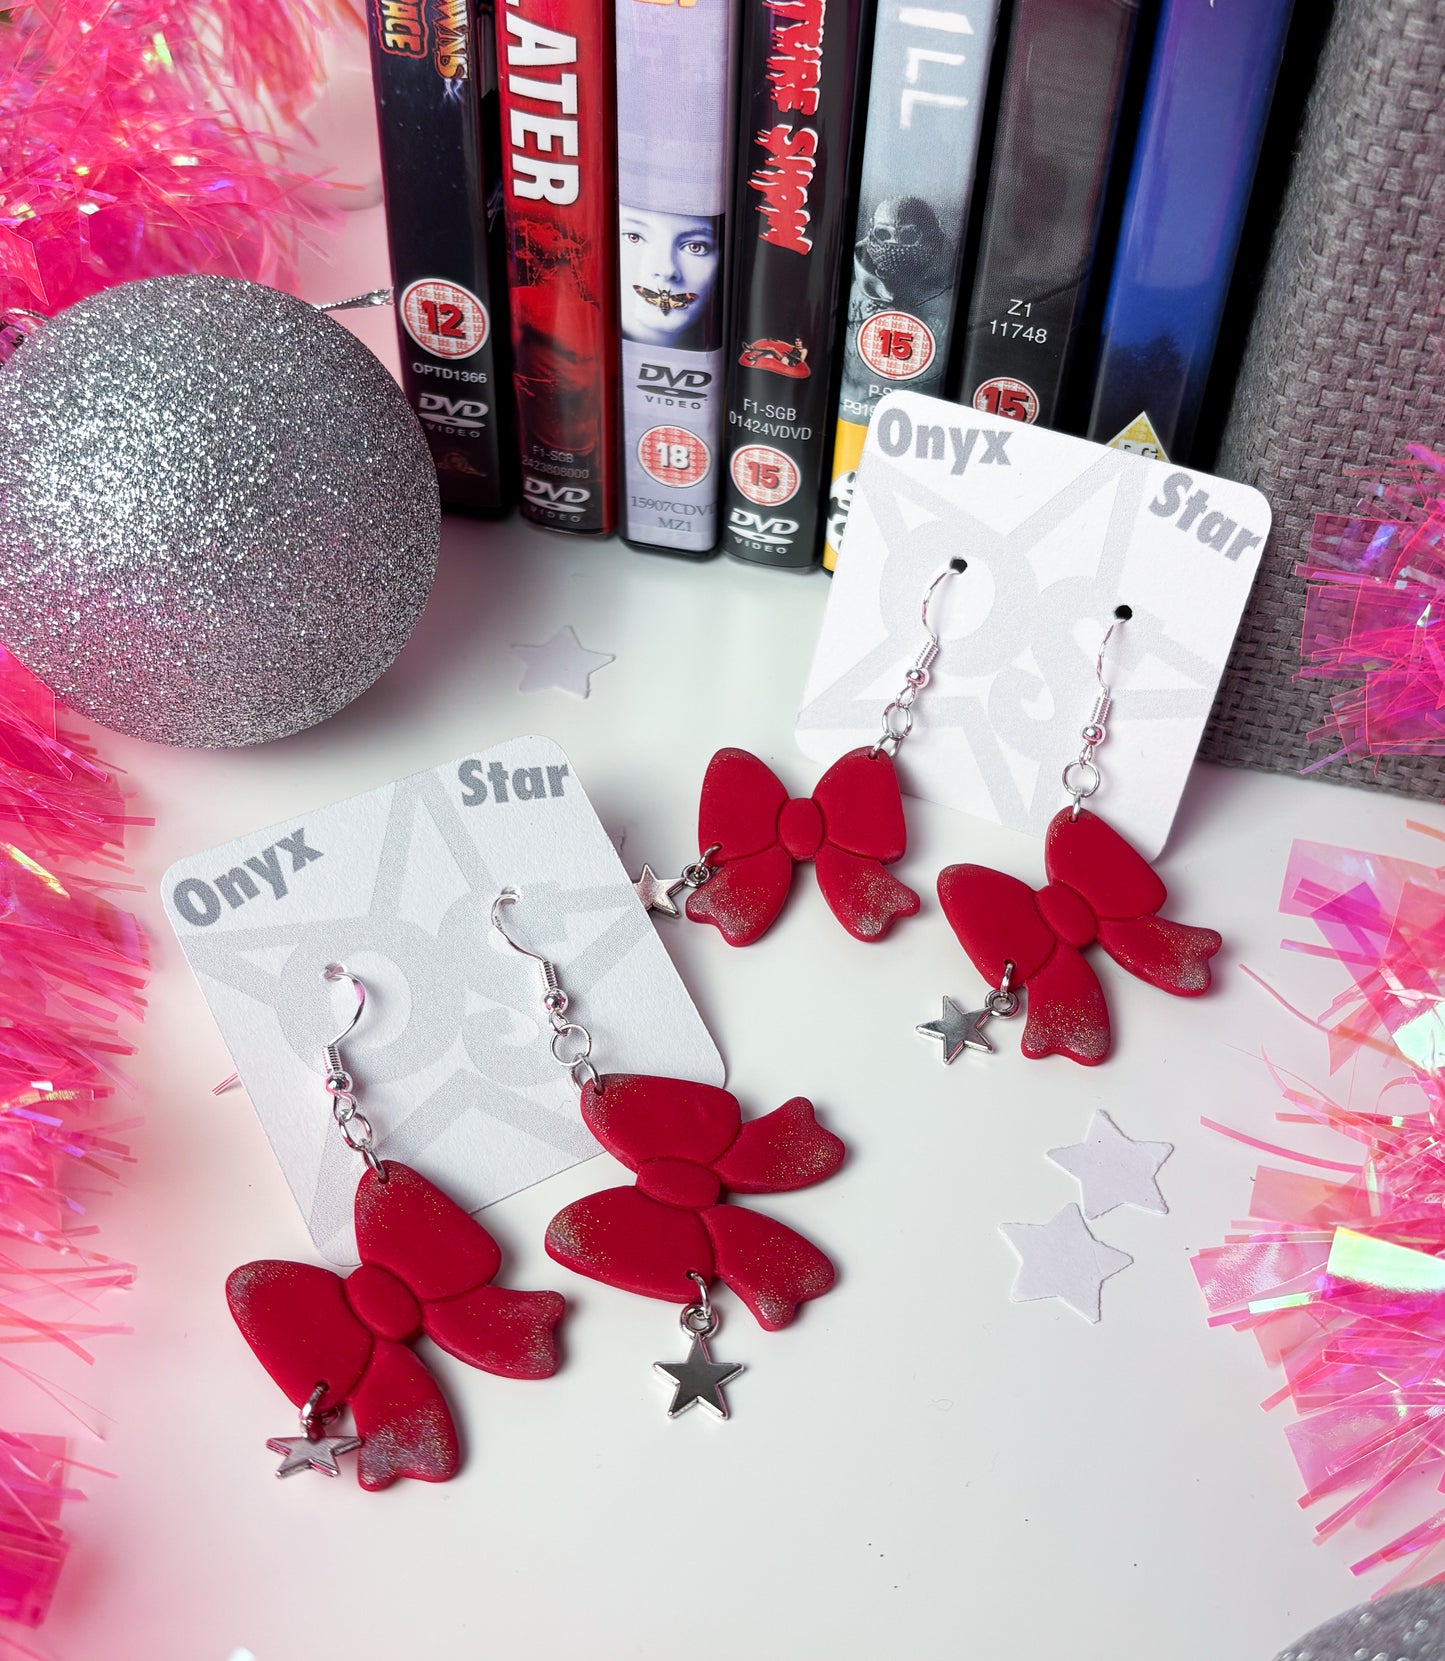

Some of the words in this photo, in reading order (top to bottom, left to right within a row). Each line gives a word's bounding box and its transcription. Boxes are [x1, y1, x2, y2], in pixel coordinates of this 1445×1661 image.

[500, 0, 580, 206] ATER
[747, 123, 819, 256] SHOW
[421, 299, 466, 341] 12
[1007, 298, 1032, 318] Z1
[877, 328, 915, 361] 15
[989, 319, 1048, 344] 11748
[411, 361, 488, 384] OPTD1366
[637, 363, 713, 388] DVD
[418, 392, 489, 418] DVD
[644, 395, 703, 410] VIDEO
[743, 398, 798, 421] F1-SGB
[981, 386, 1030, 422] 15
[425, 422, 482, 439] VIDEO
[728, 410, 813, 441] 01424VDVD
[532, 444, 575, 464] F1-SGB
[877, 408, 1013, 475] Onyx
[656, 442, 693, 470] 18
[747, 461, 780, 490] 15
[523, 477, 592, 504] DVD
[530, 505, 582, 523] VIDEO
[657, 516, 693, 533] MZ1
[729, 508, 800, 536] DVD
[1148, 472, 1264, 564] Star
[733, 536, 789, 555] VIDEO
[456, 757, 571, 808] Star
[172, 825, 326, 929] Onyx
